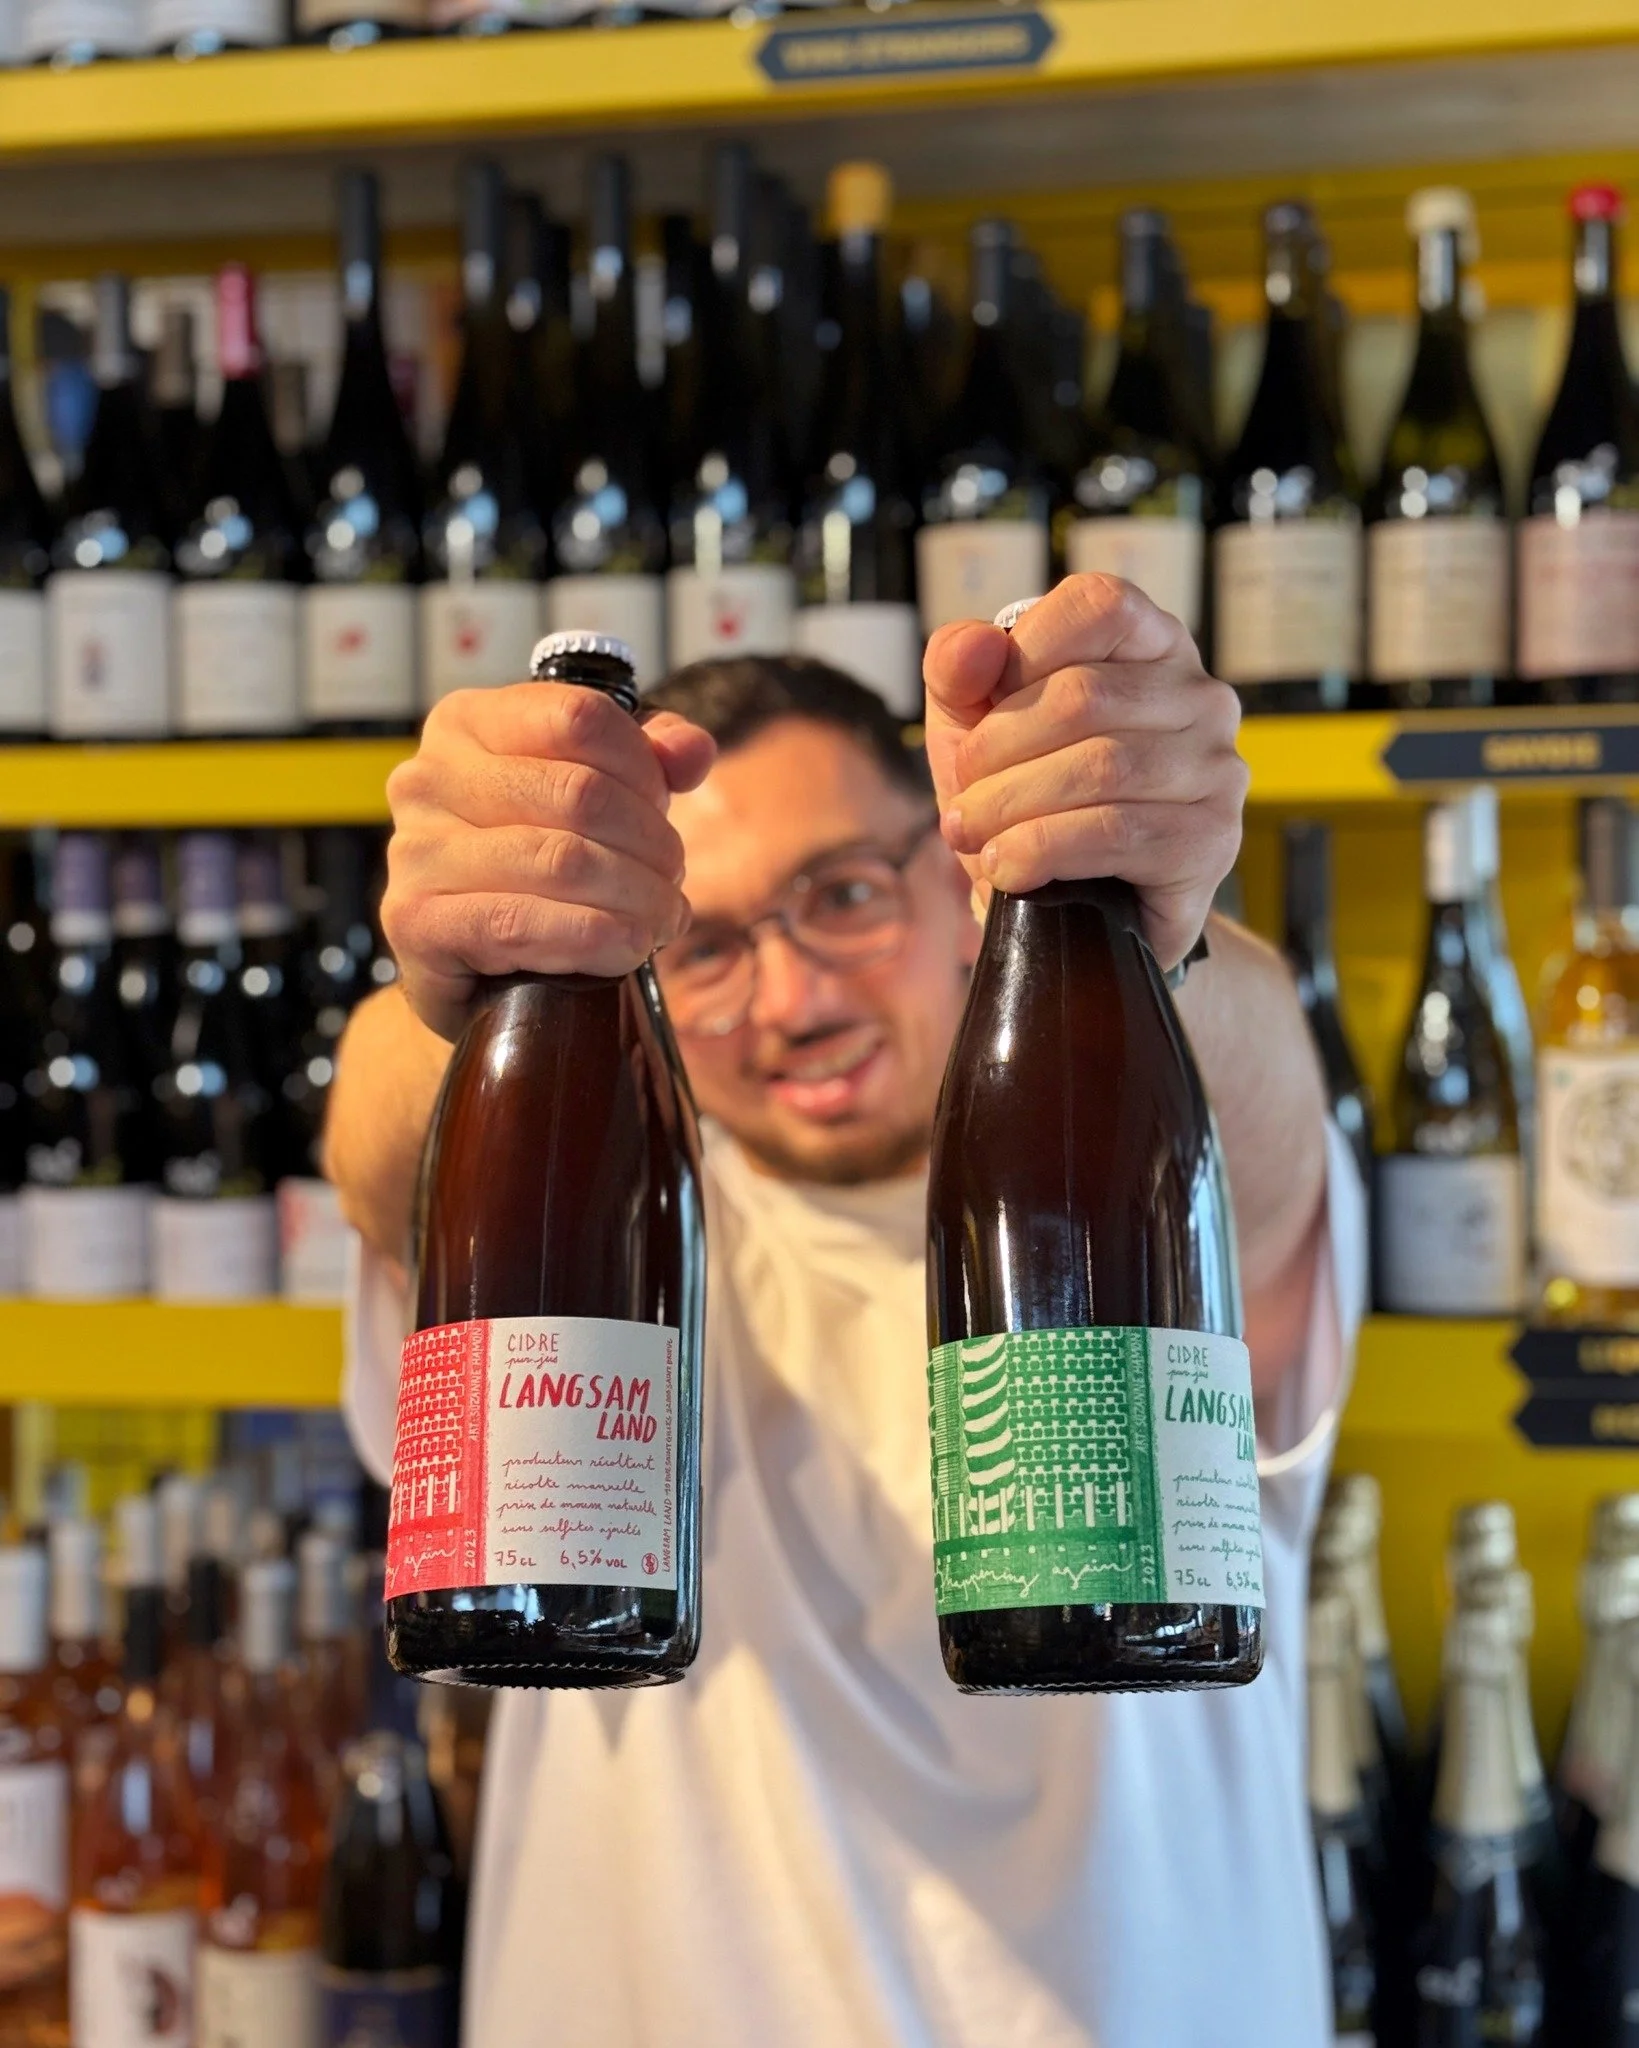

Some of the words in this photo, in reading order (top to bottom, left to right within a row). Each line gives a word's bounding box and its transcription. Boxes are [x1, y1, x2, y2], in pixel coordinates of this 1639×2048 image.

[471, 1327, 483, 1366] HAMON
[507, 1333, 560, 1352] CIDRE
[1167, 1344, 1208, 1367] CIDRE
[535, 1354, 559, 1369] jus
[470, 1370, 482, 1417] SUZANNE
[499, 1372, 652, 1415] LANGSAM
[596, 1411, 658, 1443] LAND
[663, 1498, 672, 1525] LAND
[464, 1528, 477, 1569] 2023
[1140, 1543, 1156, 1586] 2023
[1051, 1558, 1133, 1590] again
